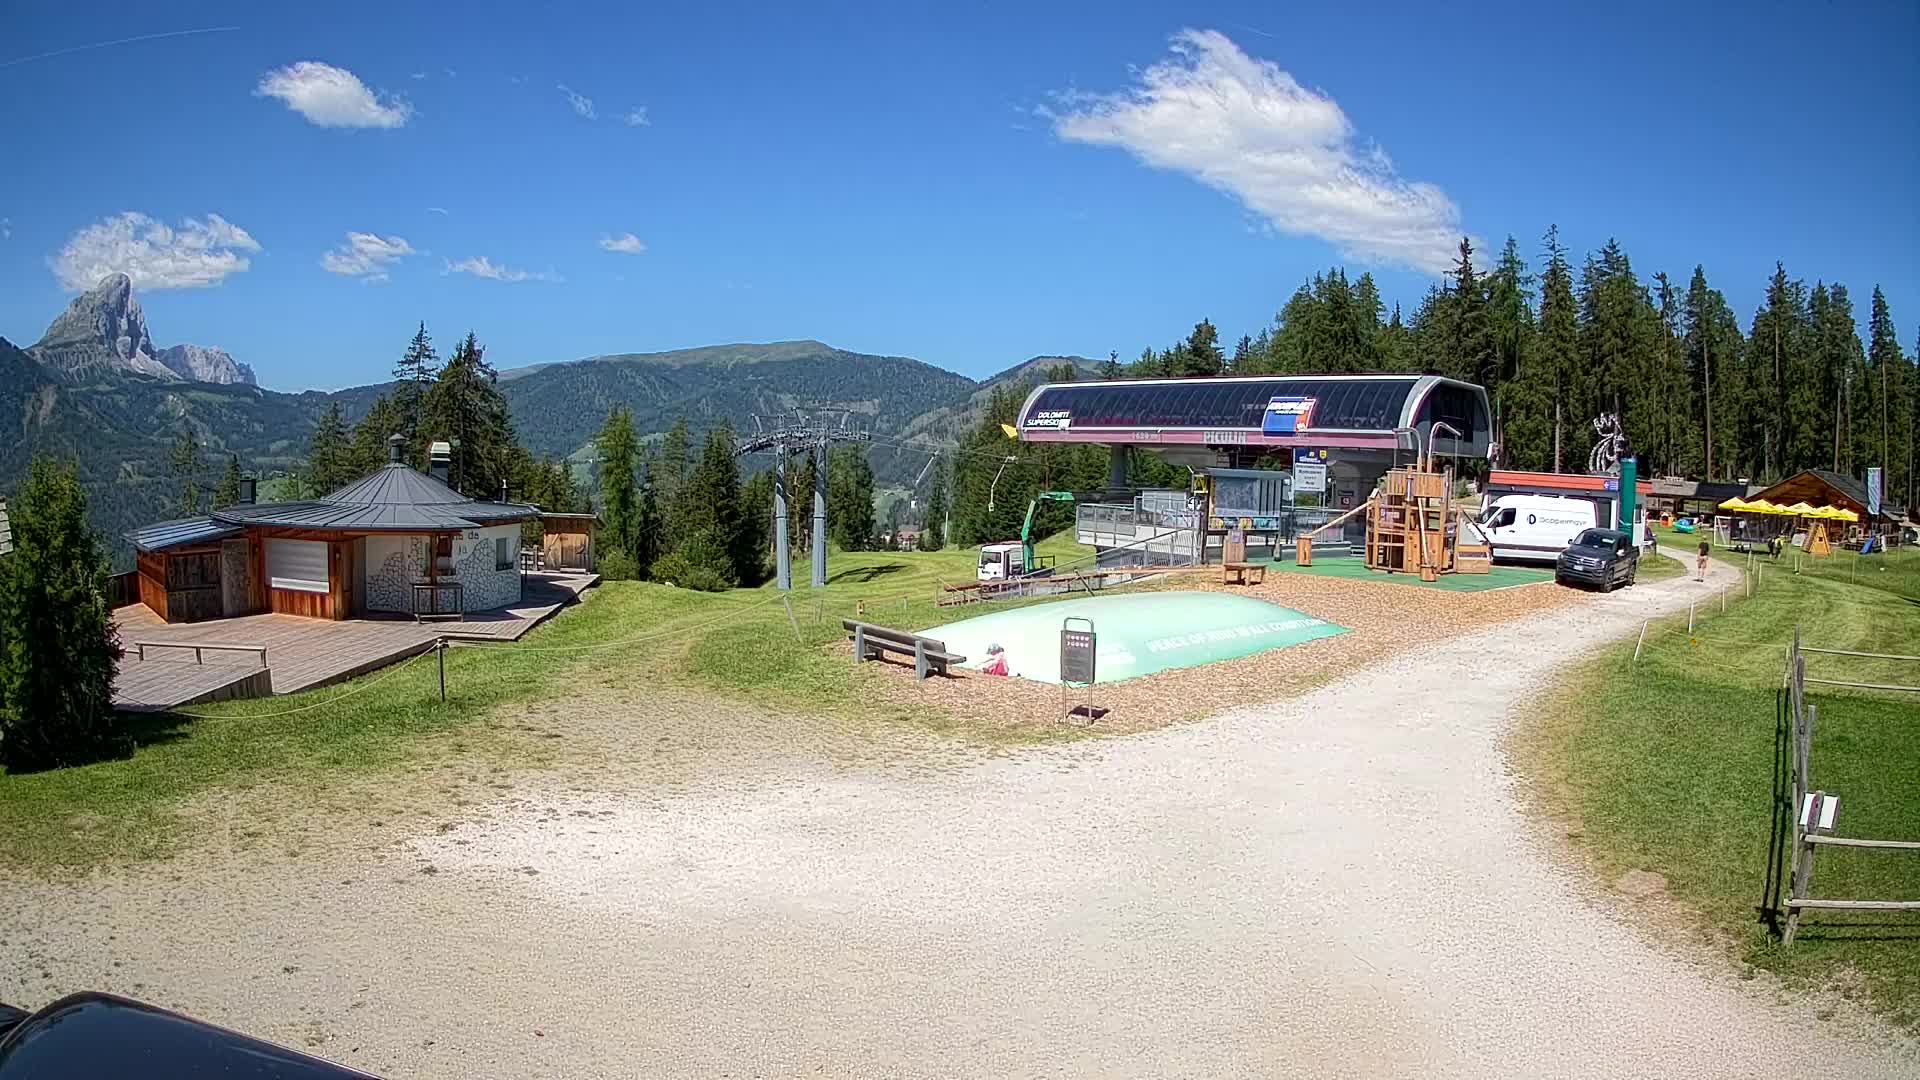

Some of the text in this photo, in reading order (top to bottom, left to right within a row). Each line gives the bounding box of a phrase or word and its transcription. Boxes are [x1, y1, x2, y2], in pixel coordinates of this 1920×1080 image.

[1204, 431, 1247, 443] PICULIN
[1146, 635, 1189, 652] PEACE
[1191, 633, 1206, 645] OF
